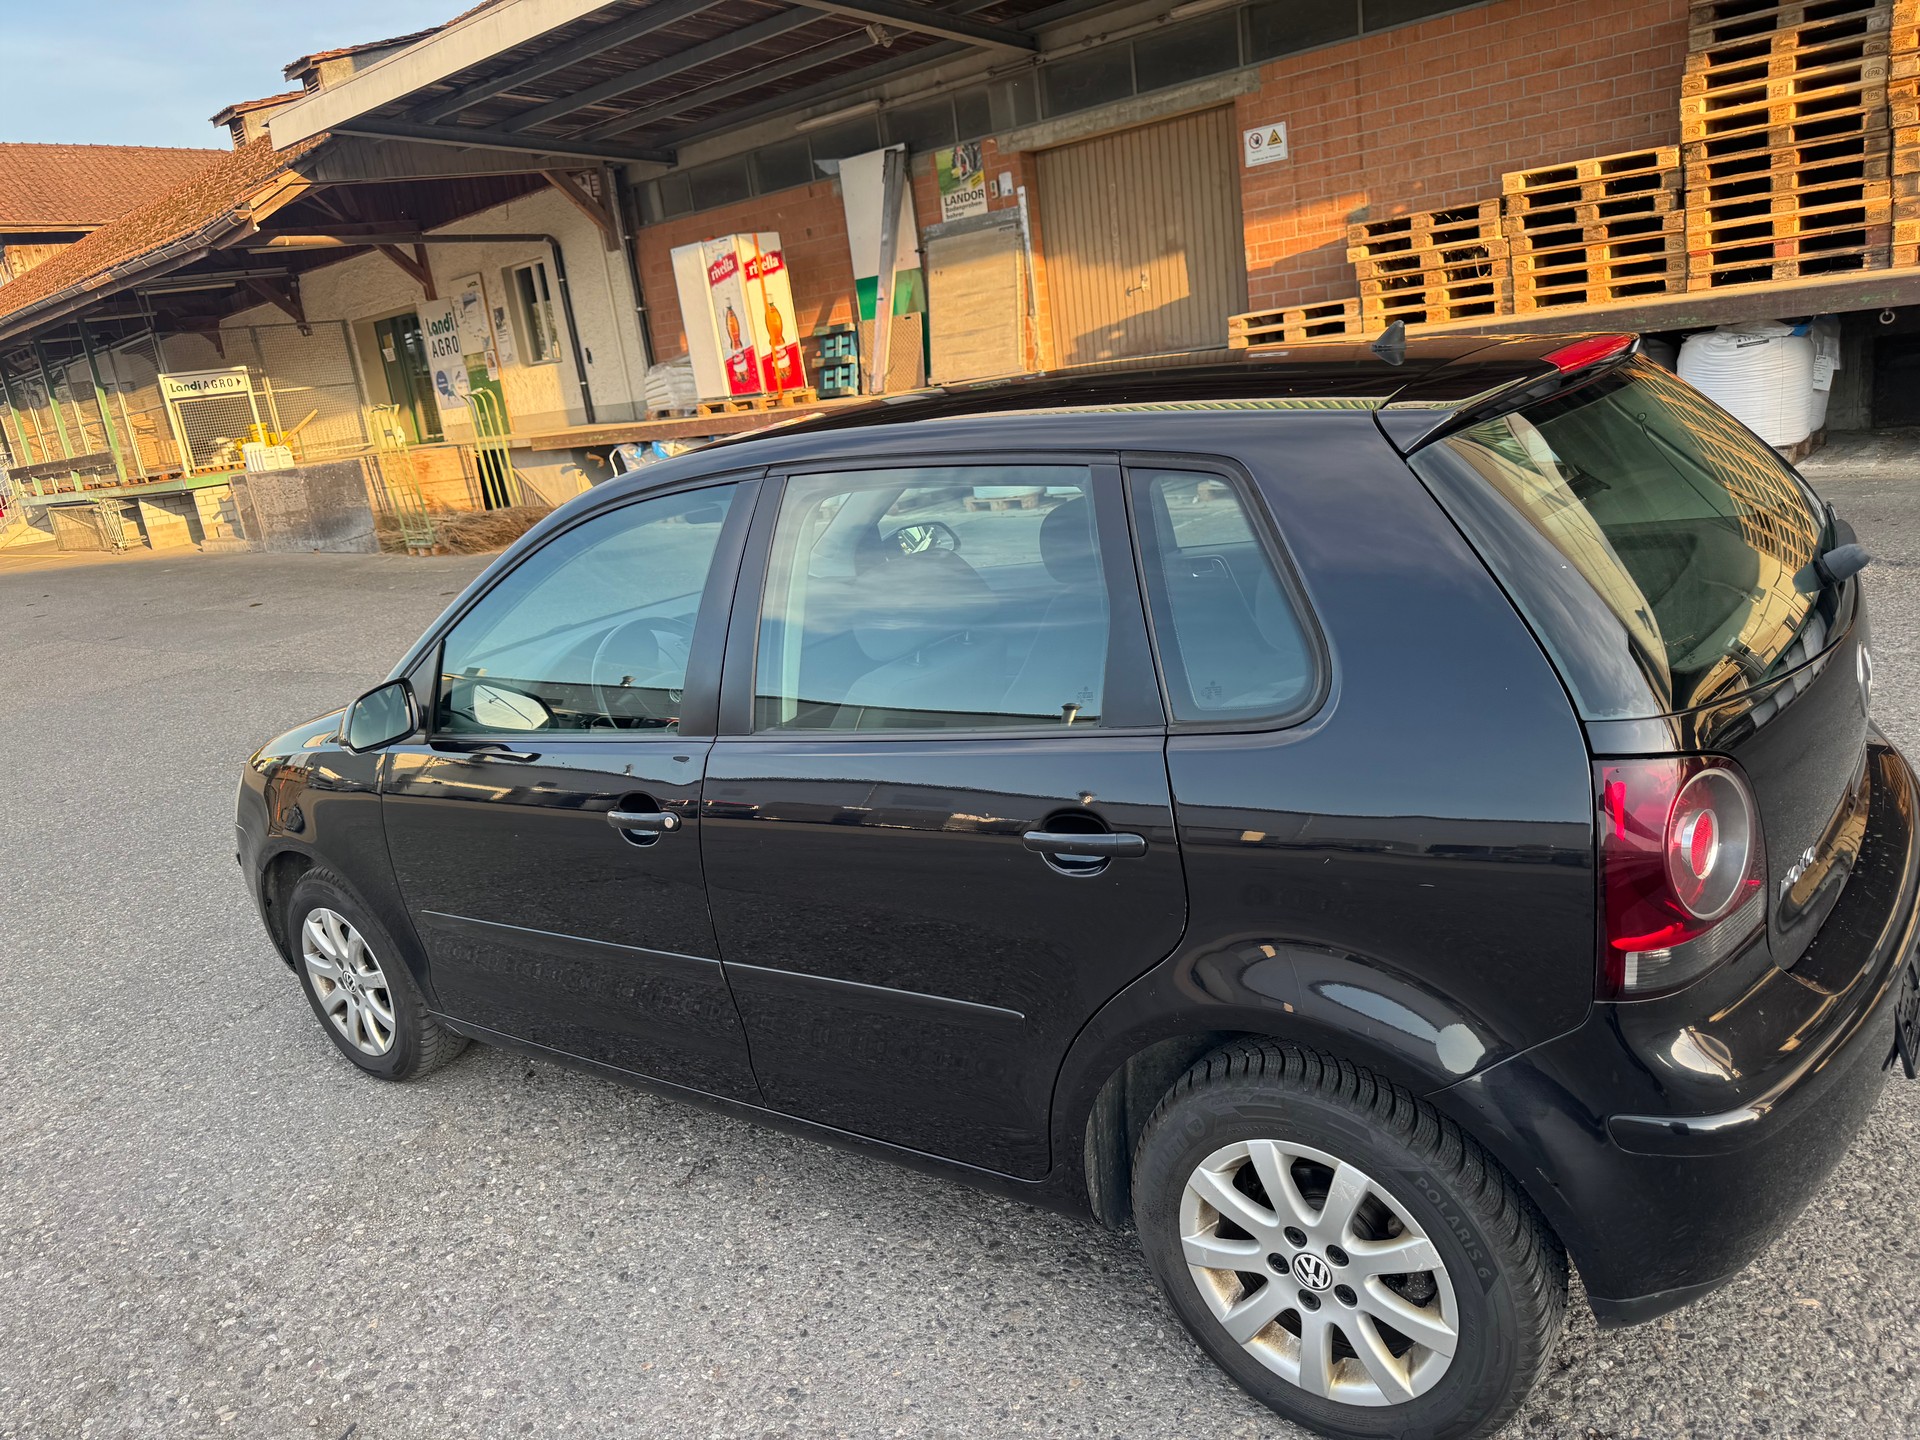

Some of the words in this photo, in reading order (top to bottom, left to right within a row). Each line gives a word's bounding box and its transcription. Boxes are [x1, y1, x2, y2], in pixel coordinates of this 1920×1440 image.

[944, 188, 985, 207] LANDOR
[711, 257, 735, 281] rivella
[748, 253, 780, 276] riella
[425, 312, 455, 337] Landi
[431, 335, 459, 358] AGRO
[170, 381, 202, 393] Landi
[203, 377, 234, 390] AGRO
[1415, 1176, 1484, 1261] POLARIS
[1477, 1266, 1492, 1279] 6
